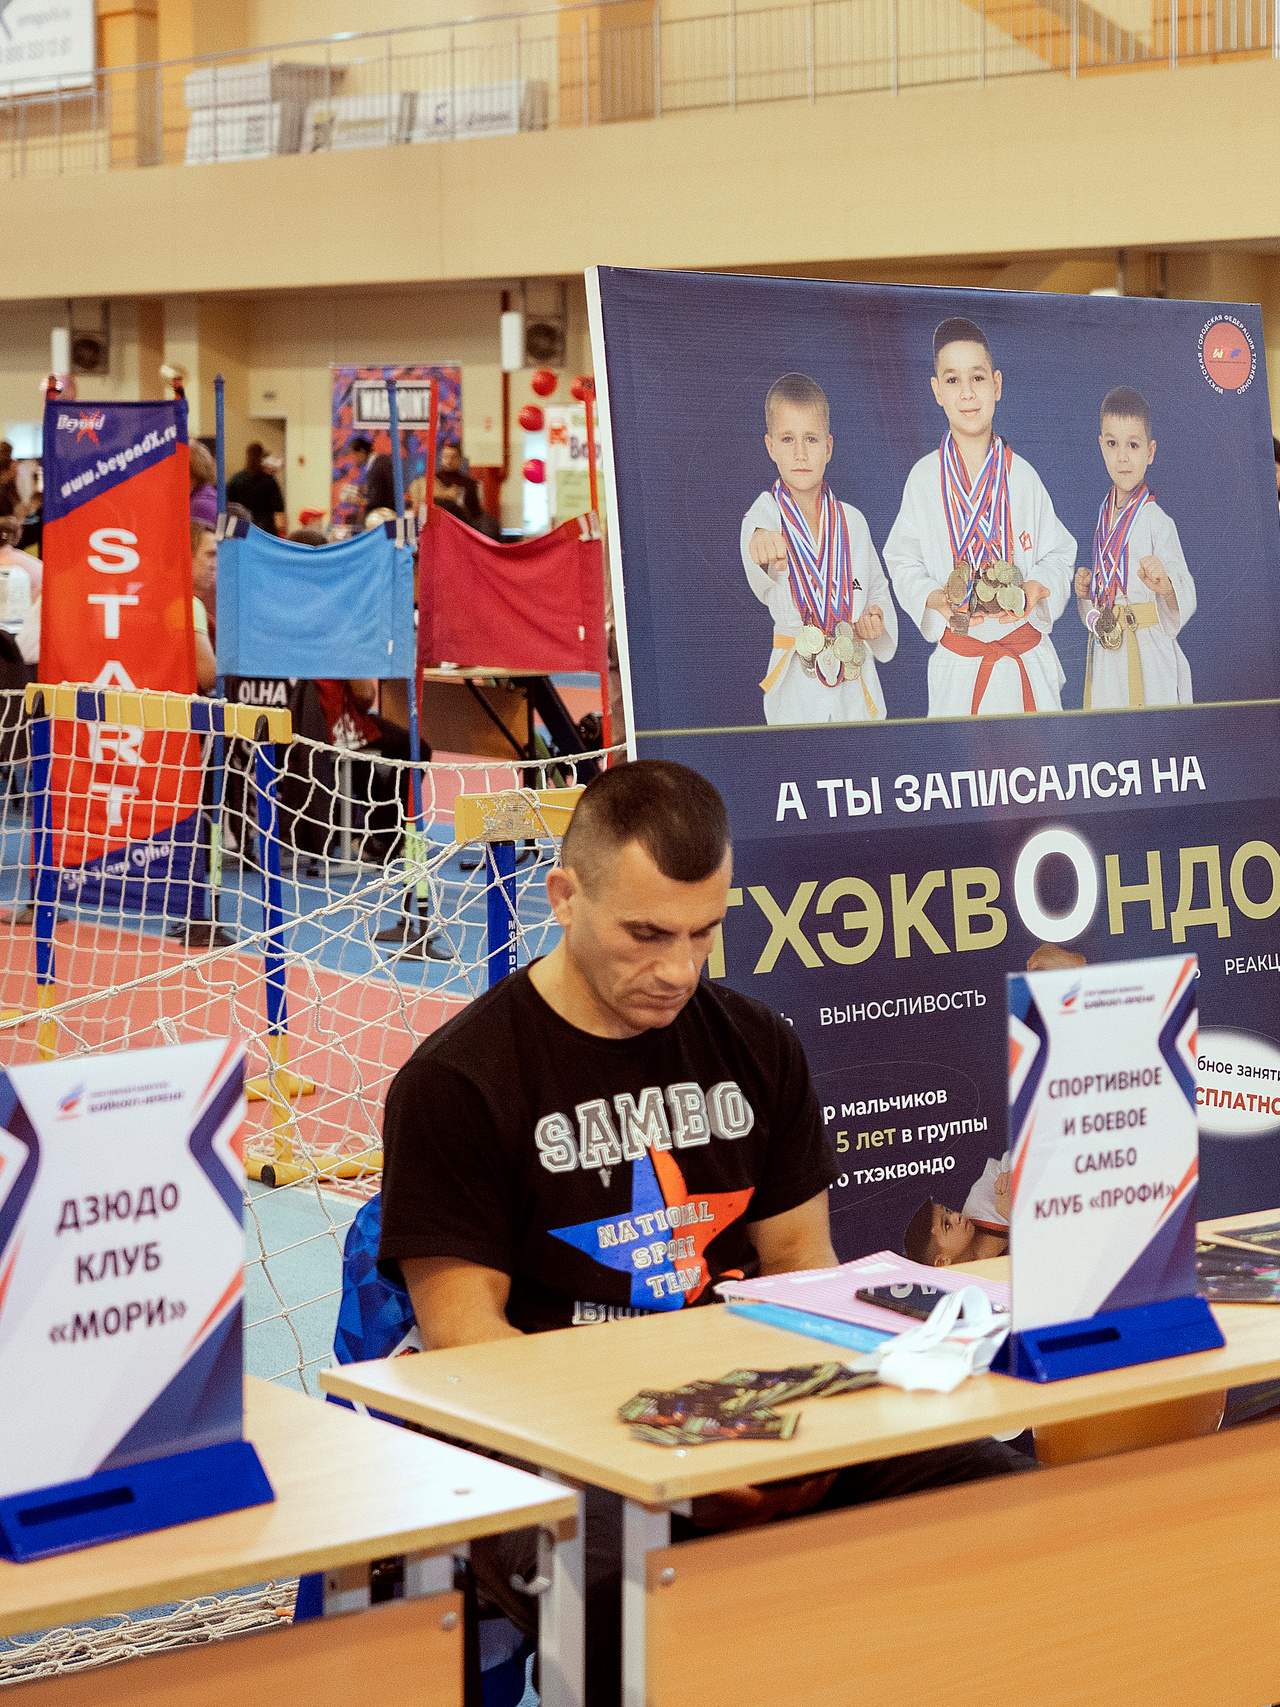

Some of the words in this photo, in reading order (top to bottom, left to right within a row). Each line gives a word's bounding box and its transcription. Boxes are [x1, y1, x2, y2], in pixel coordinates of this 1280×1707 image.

[238, 680, 288, 705] OLHA
[775, 782, 807, 821] А
[816, 776, 883, 818] ТЫ
[894, 759, 1142, 813] ЗАПИСАЛСЯ
[1151, 755, 1206, 794] НА
[819, 988, 987, 1027] ВЫНОСЛИВОСТЬ
[1197, 1055, 1233, 1076] бное
[1049, 1067, 1162, 1100] СПОРТИВНОЕ
[841, 1089, 948, 1118] мальчиков
[535, 1081, 755, 1174] SAMBO
[836, 1130, 850, 1153] 5
[855, 1127, 896, 1151] лет
[901, 1128, 913, 1143] в
[917, 1116, 988, 1143] группы
[1063, 1117, 1077, 1136] И
[1081, 1107, 1148, 1134] БОЕВОЕ
[853, 1155, 956, 1185] тхэквондо
[1075, 1147, 1137, 1174] САМБО
[56, 1182, 179, 1236] ДЗЮДО
[1034, 1193, 1083, 1220] КЛУБ
[1089, 1181, 1177, 1210] «ПРОФИ»
[76, 1241, 162, 1285] КЛУБ
[631, 1235, 696, 1270] SPORT
[646, 1266, 702, 1298] TEAM
[49, 1296, 187, 1344] «МОРИ»
